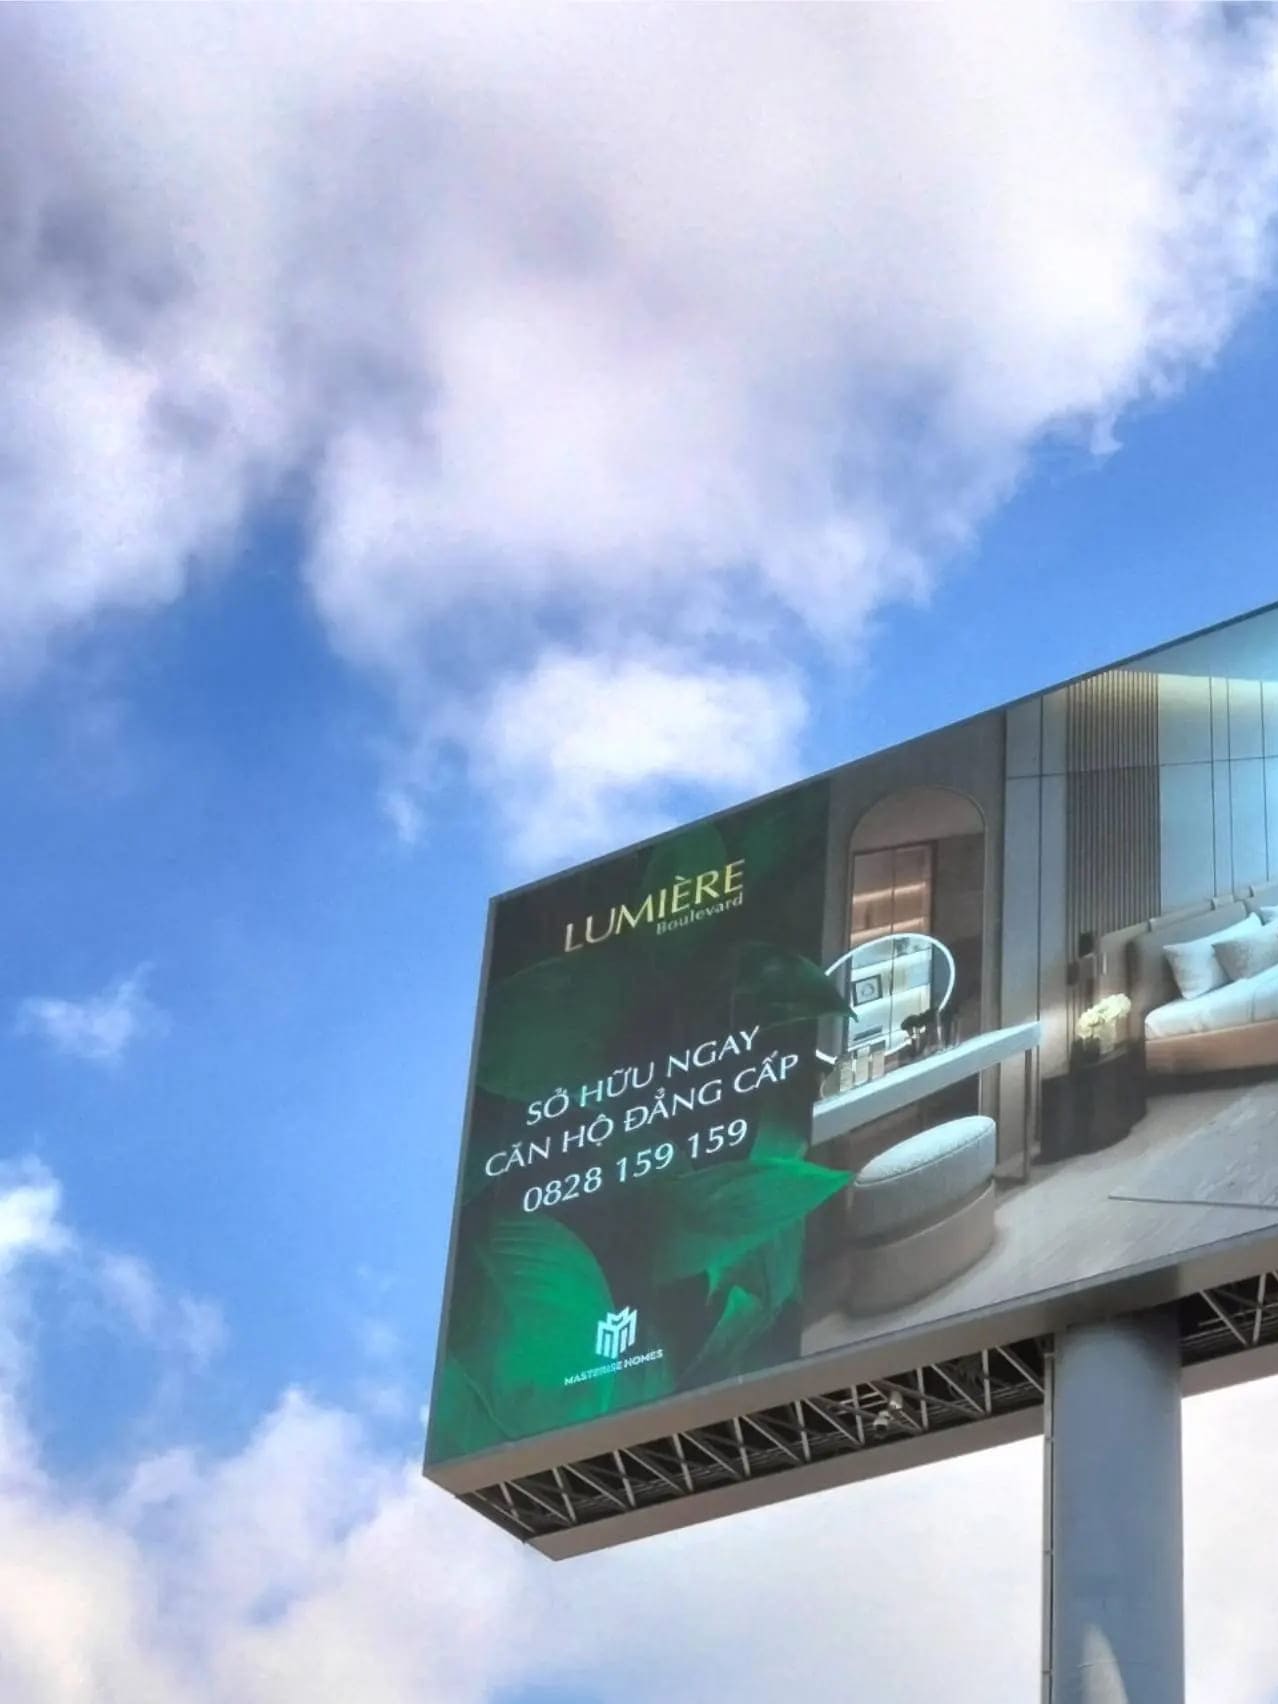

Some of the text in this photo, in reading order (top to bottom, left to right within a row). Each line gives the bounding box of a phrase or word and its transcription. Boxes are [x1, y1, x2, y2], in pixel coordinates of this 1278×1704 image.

[564, 858, 745, 952] LUMIÈRE
[656, 892, 744, 935] Boulevard
[484, 1050, 798, 1177] CĂN HỘ ĐẲNG CẤP
[525, 1025, 760, 1126] SỞ HỮU NGAY
[523, 1118, 748, 1213] 0828 159 159
[624, 1349, 664, 1368] HOMES
